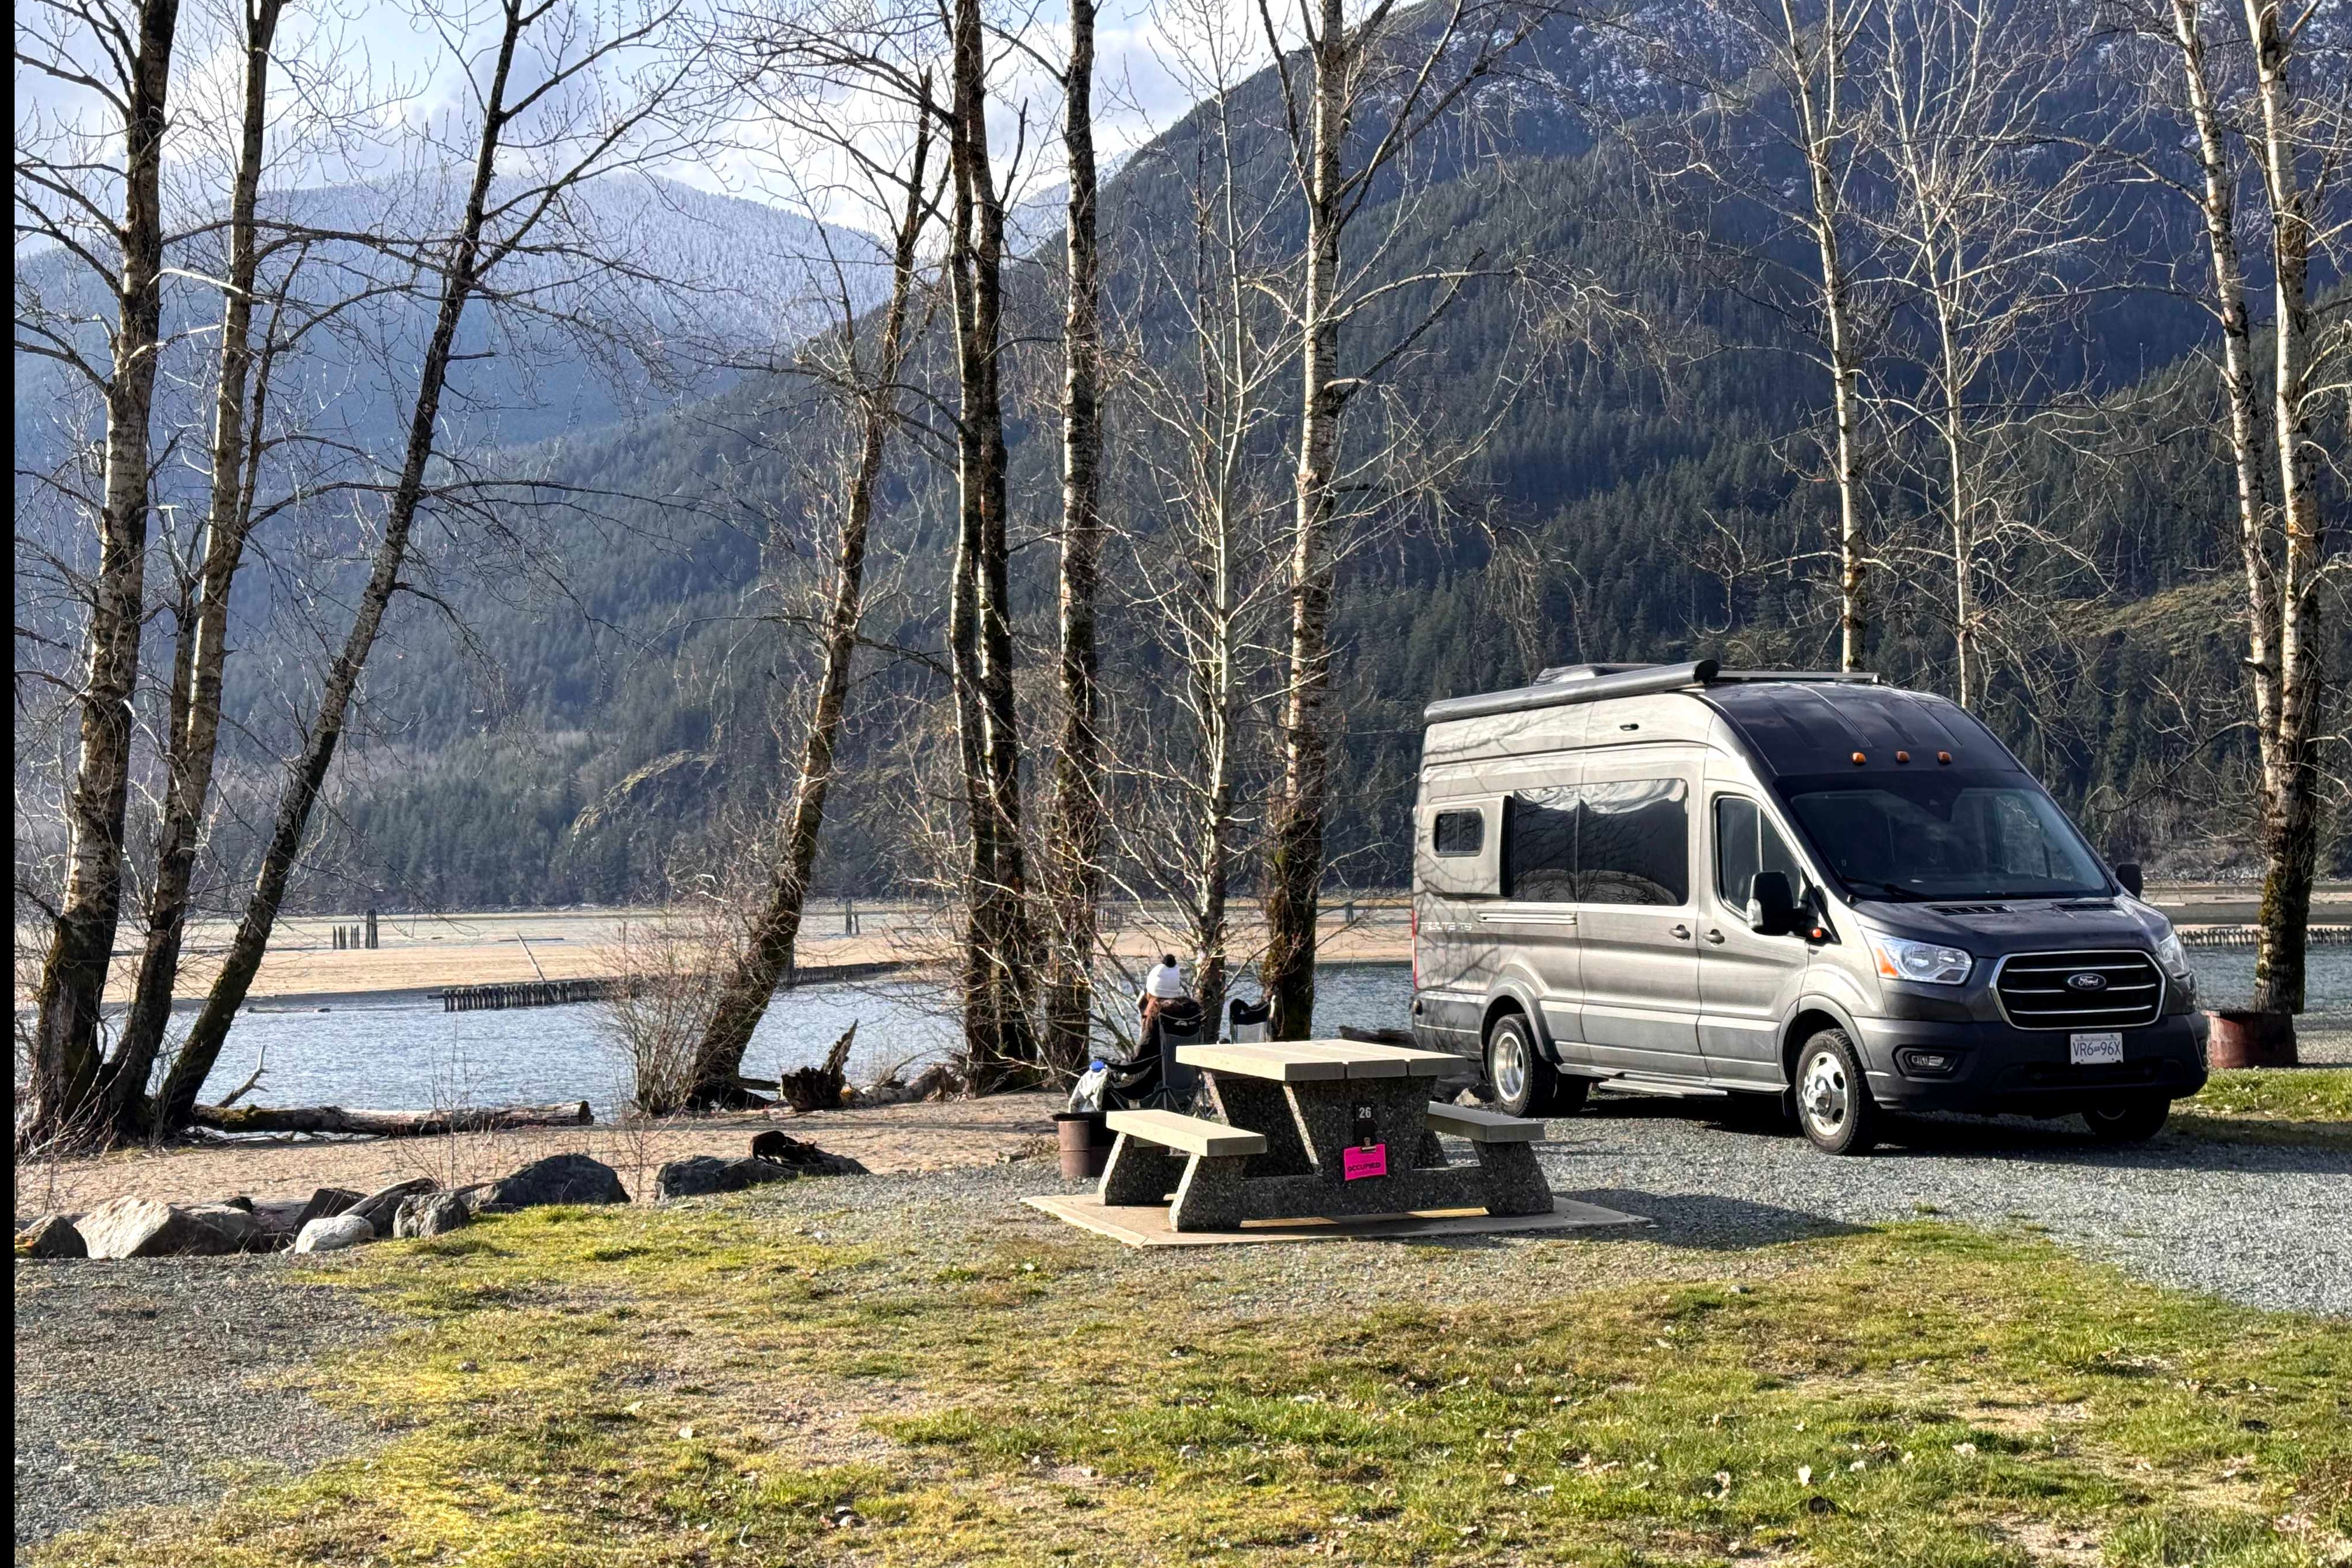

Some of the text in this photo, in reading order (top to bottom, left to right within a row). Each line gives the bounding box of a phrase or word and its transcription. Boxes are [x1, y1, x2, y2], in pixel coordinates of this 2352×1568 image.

[2078, 976, 2099, 986] Ford
[1359, 1107, 1371, 1118] 26
[1347, 1161, 1381, 1172] OCCUPIED
